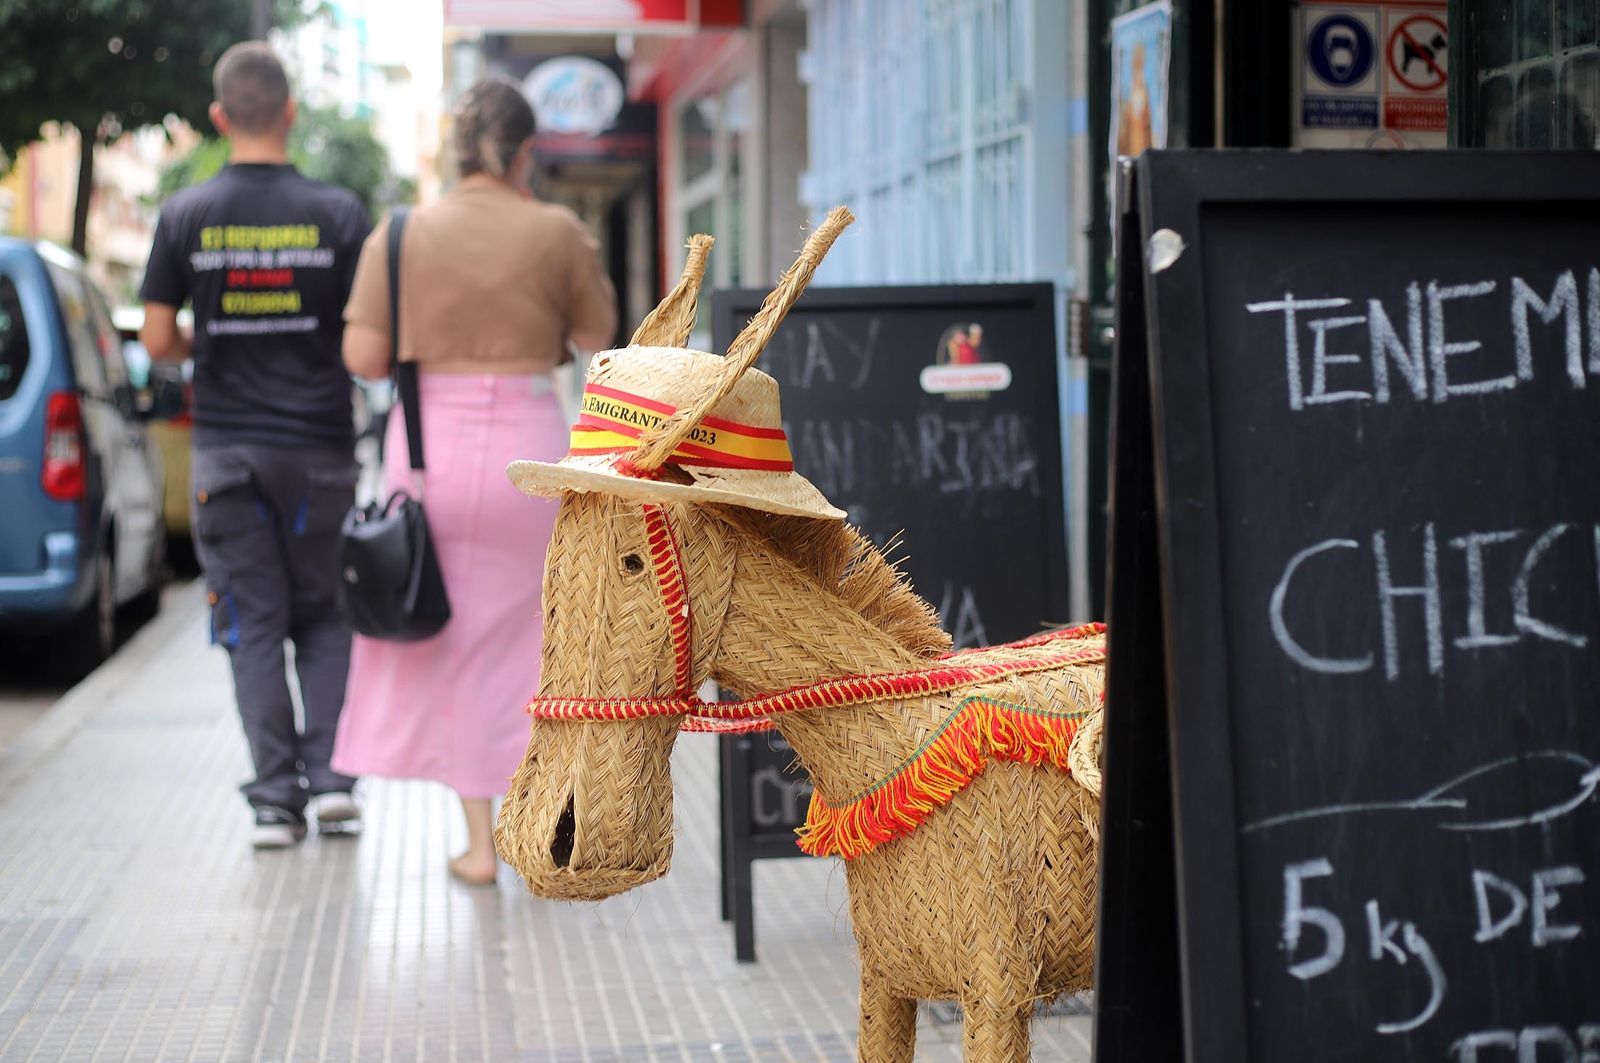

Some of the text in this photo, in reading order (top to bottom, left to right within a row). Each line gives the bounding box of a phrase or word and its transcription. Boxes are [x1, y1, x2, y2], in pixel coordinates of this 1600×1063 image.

[588, 397, 668, 430] EMIGRANT
[686, 427, 716, 445] 023
[1270, 521, 1600, 683] CHIC
[1282, 857, 1346, 980] 5
[1472, 866, 1586, 947] DE
